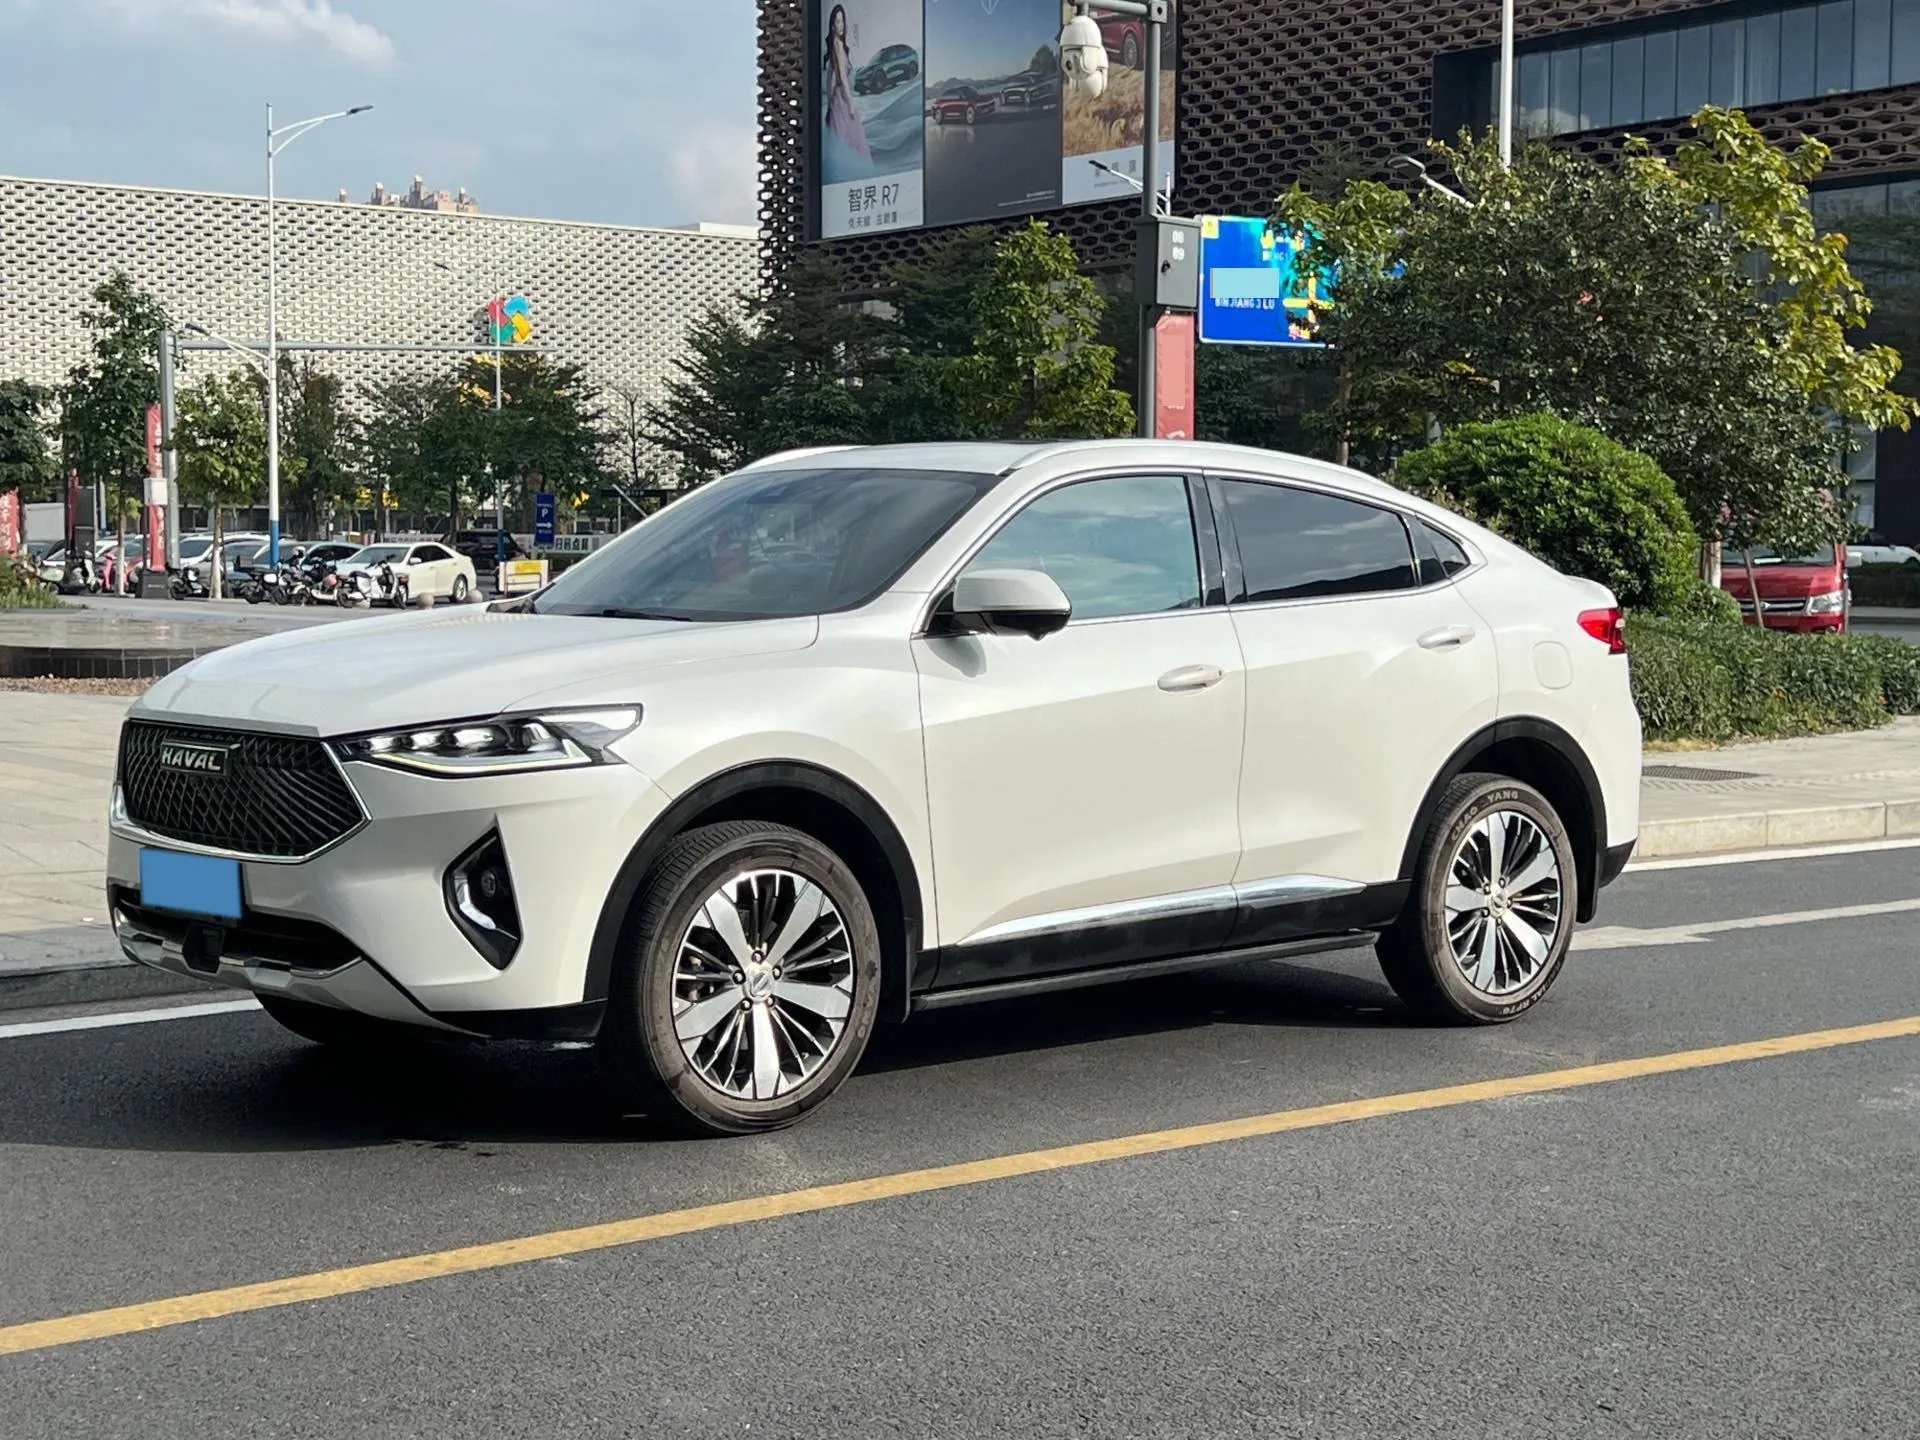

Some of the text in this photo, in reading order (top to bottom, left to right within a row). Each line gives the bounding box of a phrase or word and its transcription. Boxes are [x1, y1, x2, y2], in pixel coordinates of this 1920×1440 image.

[848, 183, 899, 212] 智界 R7
[161, 747, 221, 771] HAVAL
[1487, 790, 1519, 804] YANG
